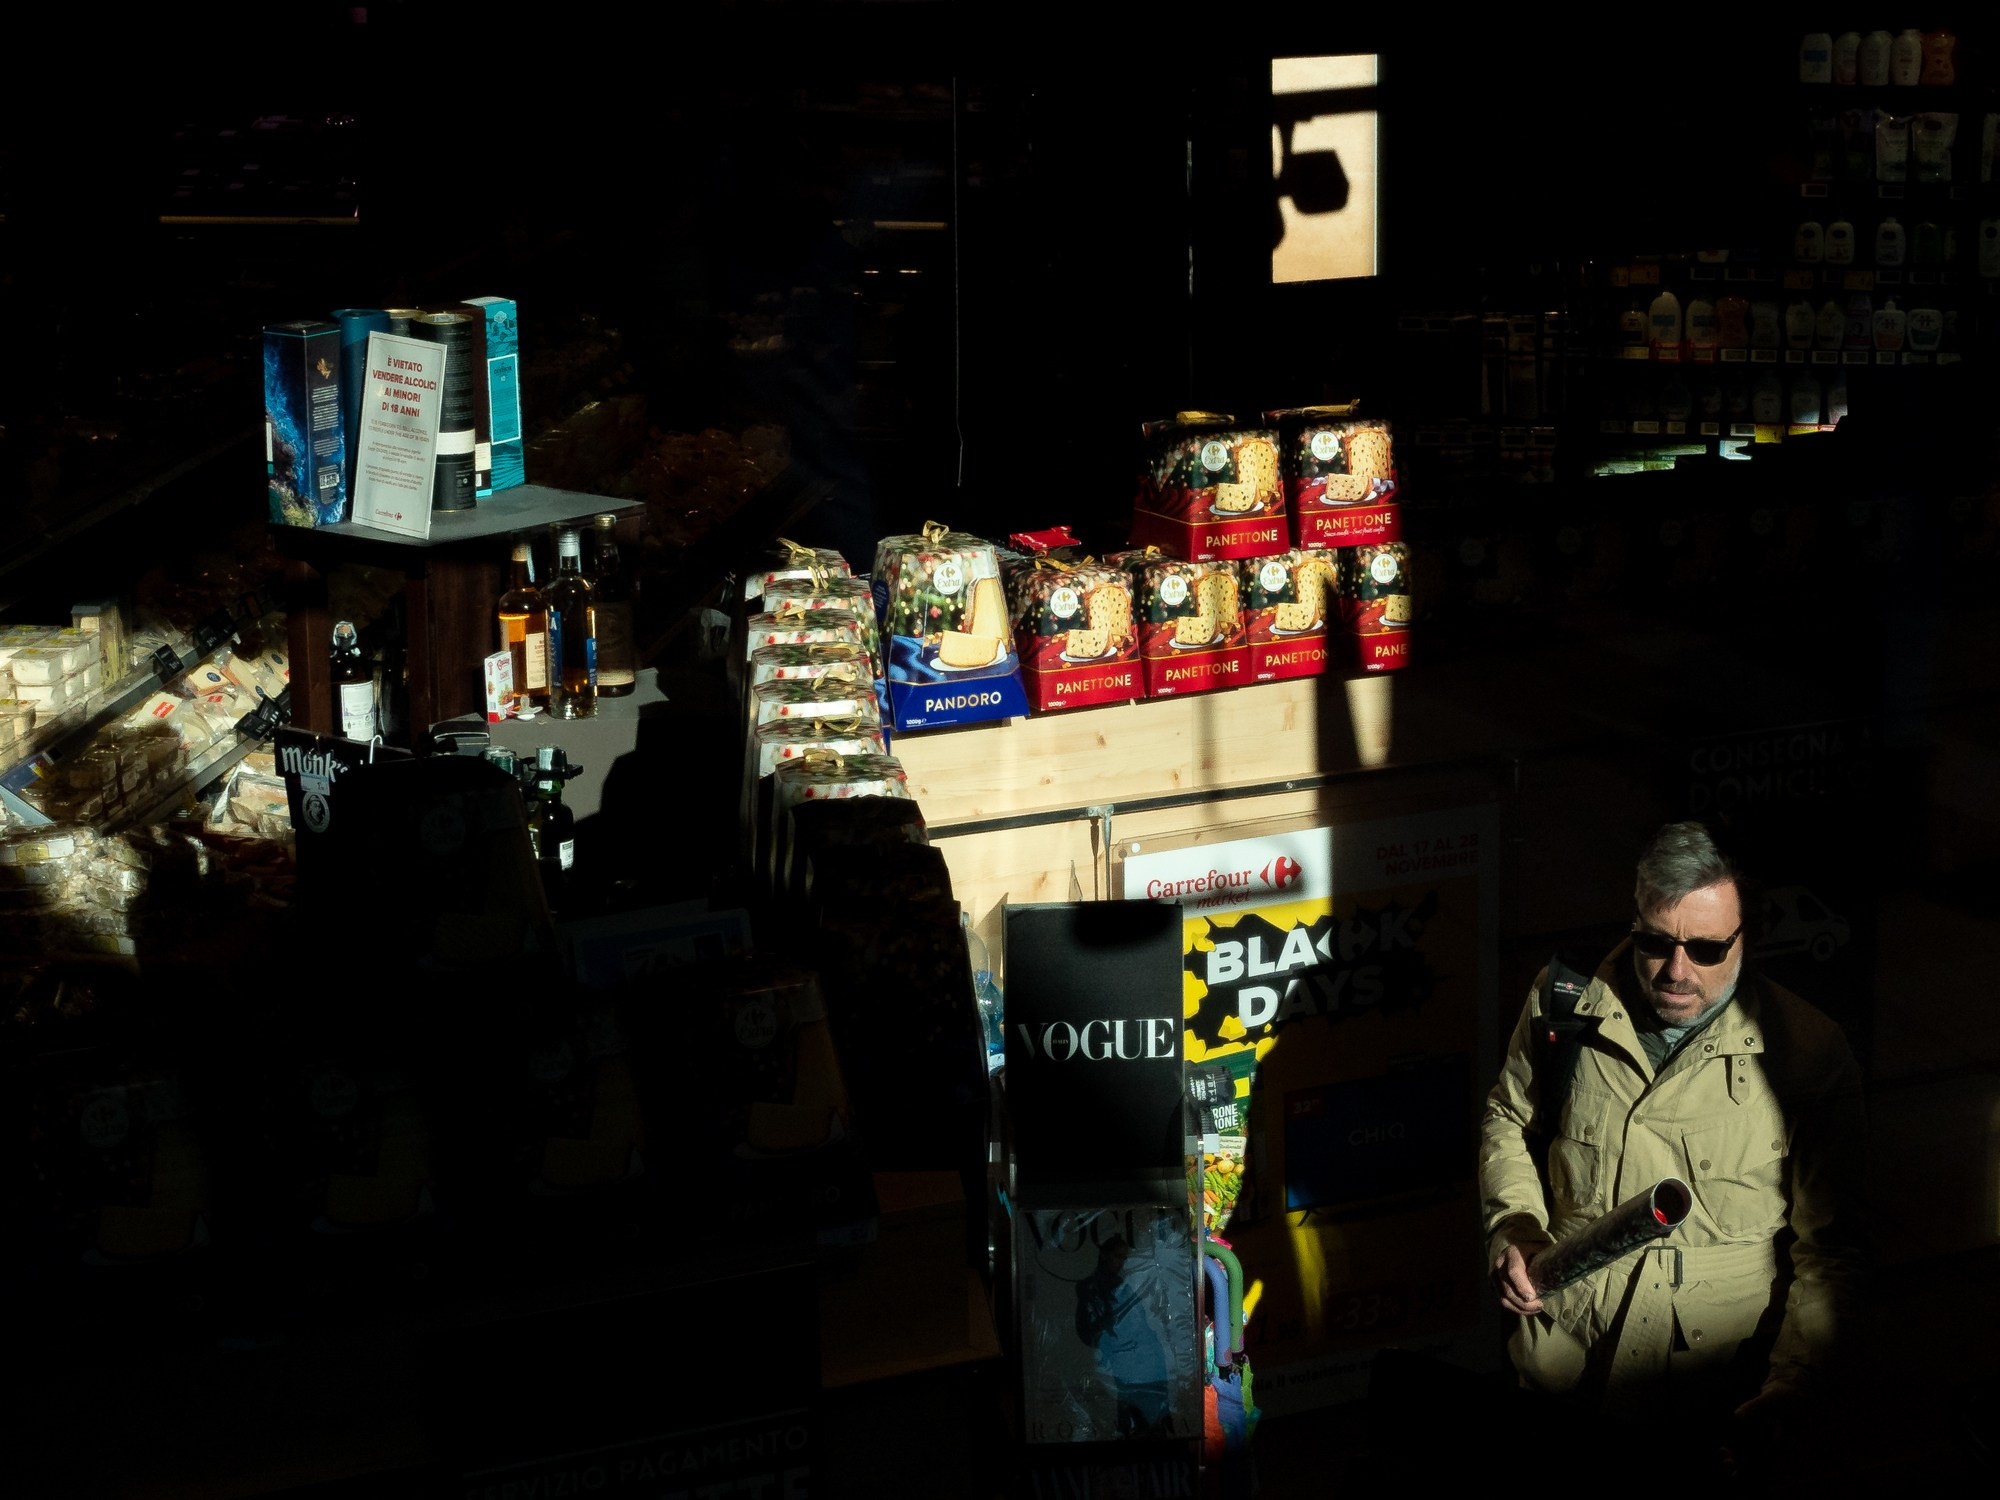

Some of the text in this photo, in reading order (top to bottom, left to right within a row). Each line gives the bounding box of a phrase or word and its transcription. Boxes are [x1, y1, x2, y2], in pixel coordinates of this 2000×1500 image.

[387, 355, 423, 372] È VIETATO
[372, 369, 437, 391] VENDERE ALCOLICI
[384, 387, 421, 402] AI MINORI
[381, 401, 420, 417] DI 18 ANNI
[1316, 512, 1392, 530] PANETTONE
[1206, 529, 1278, 548] PANETTONE
[1265, 648, 1329, 667] PANETTON
[1165, 660, 1239, 681] PANETTONE
[1056, 673, 1132, 695] PANETTONE
[925, 691, 1002, 712] PANDORO
[1376, 833, 1479, 861] DAL 17 AL 28
[1386, 849, 1479, 876] NOVEMBRE
[1146, 869, 1252, 900] Carrefour
[1196, 890, 1252, 909] market
[1238, 963, 1384, 1029] DAYS
[1017, 1018, 1175, 1062] VOGUE
